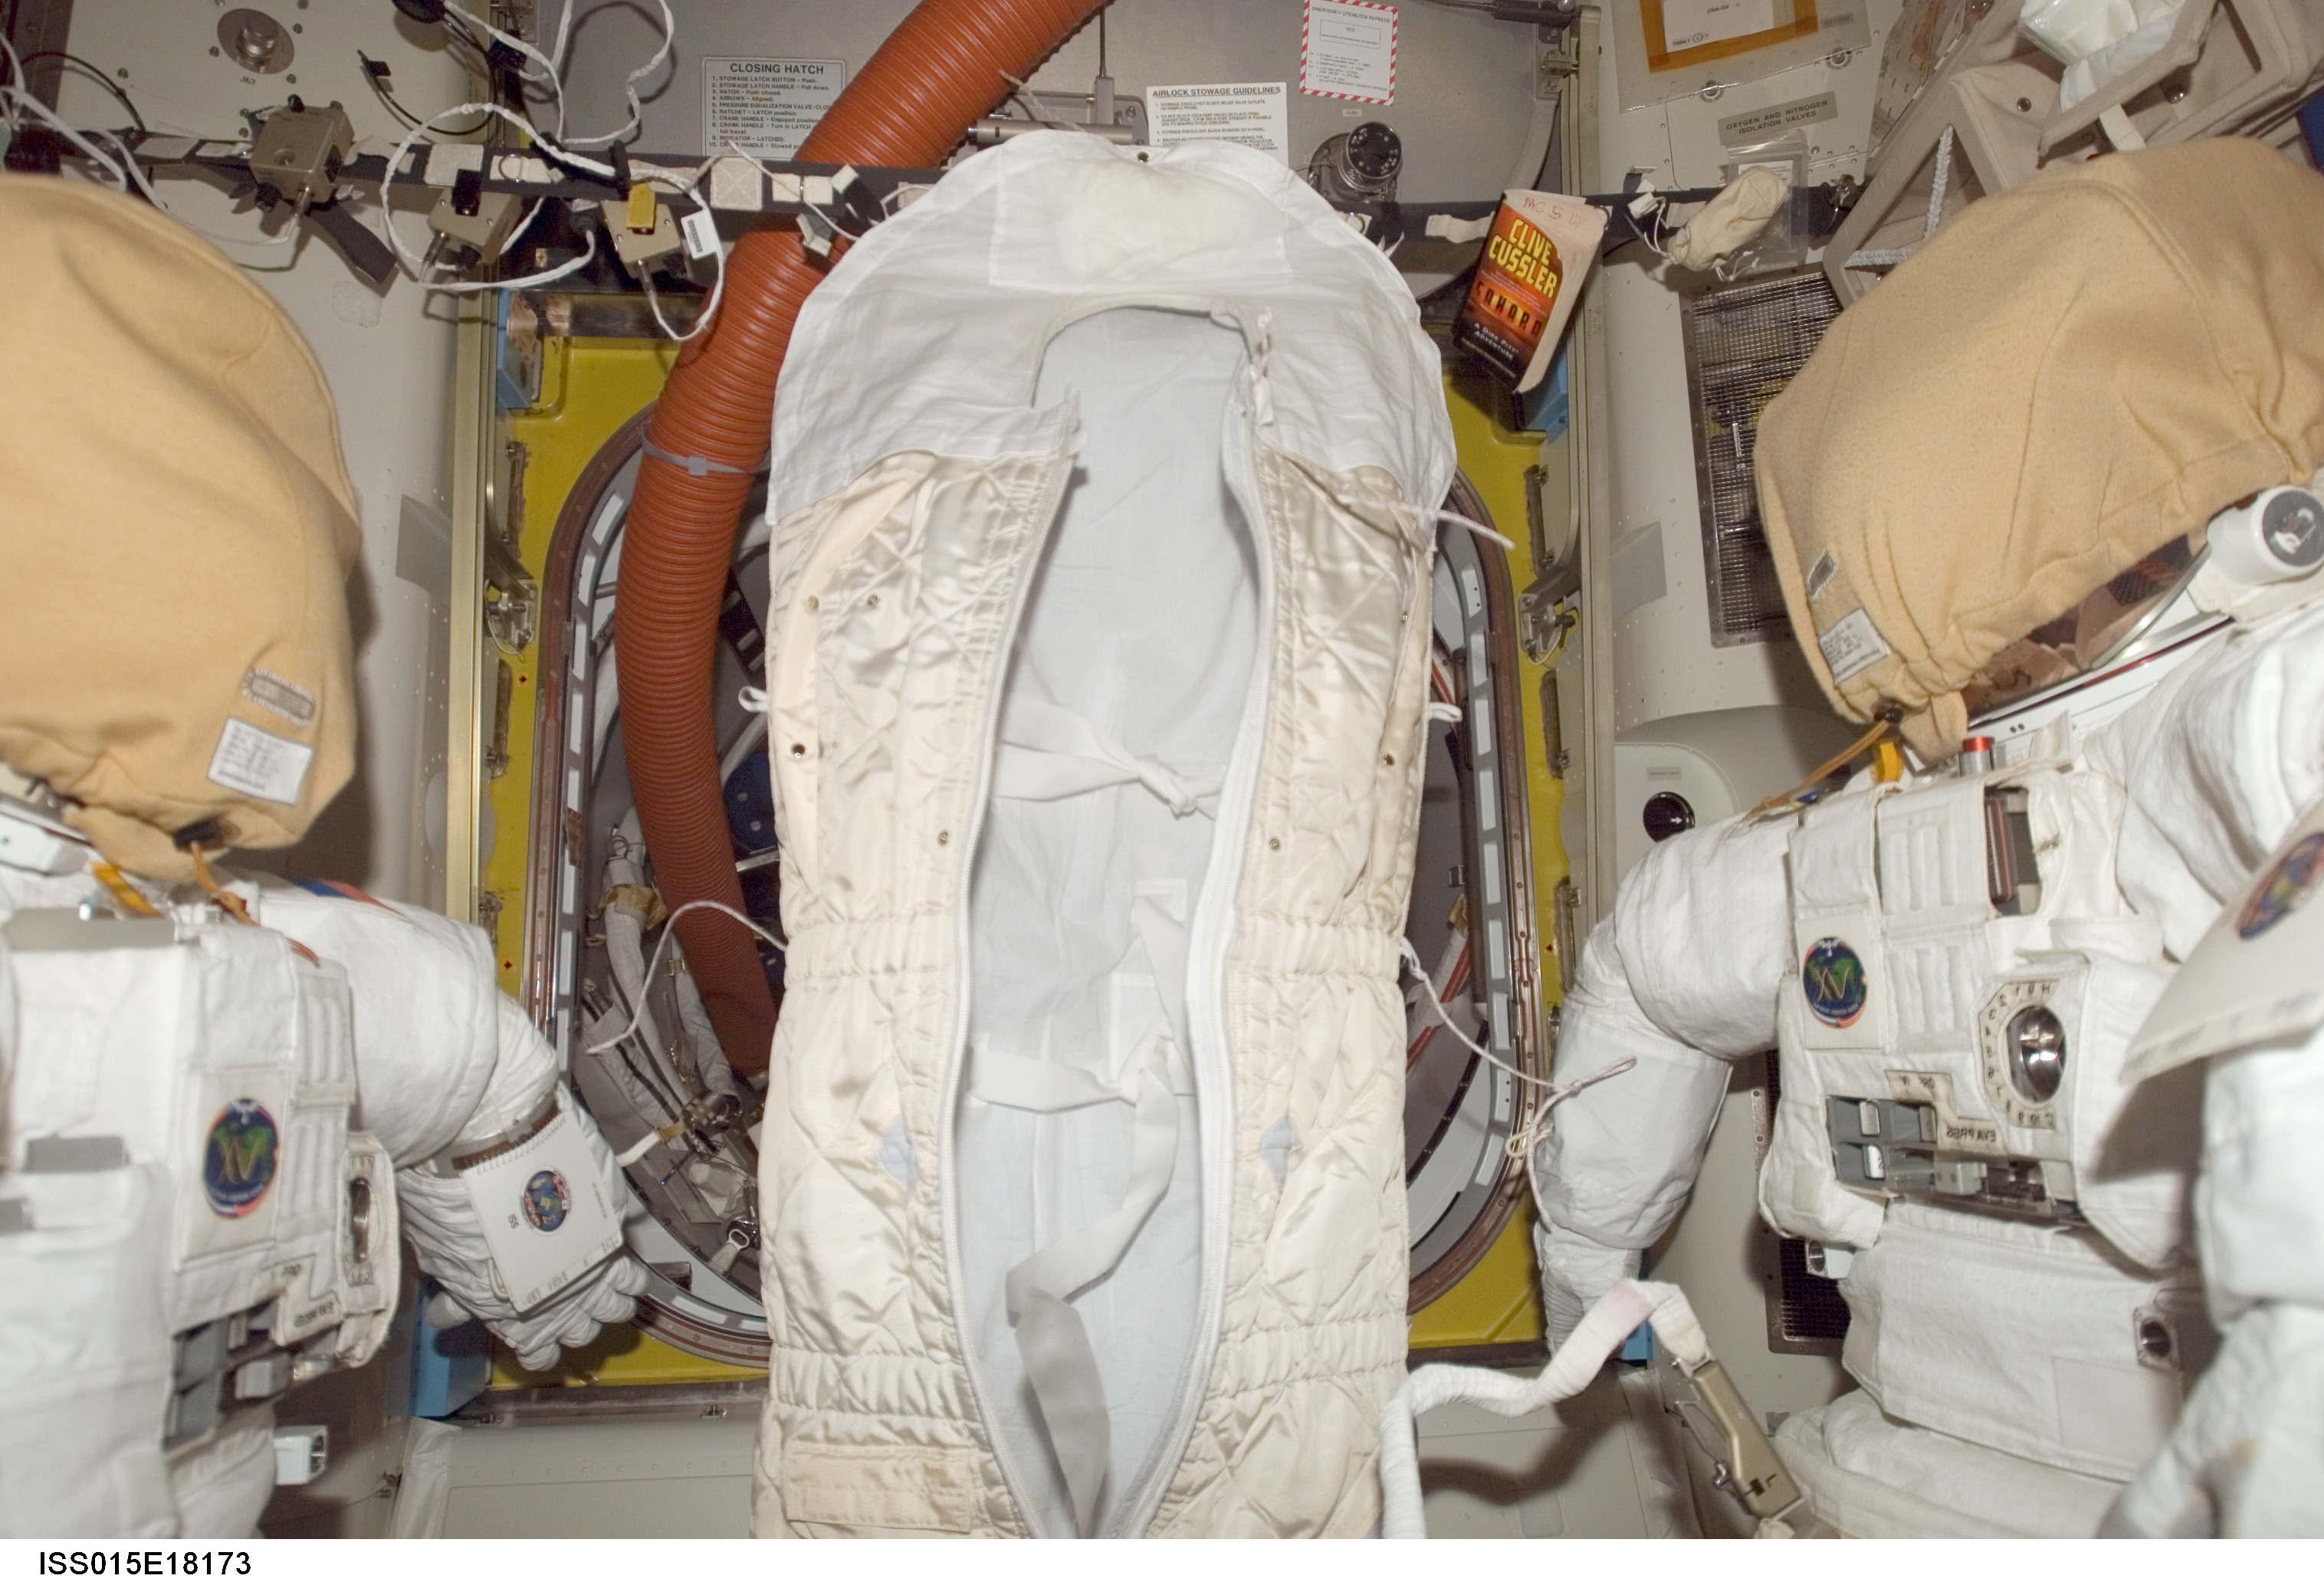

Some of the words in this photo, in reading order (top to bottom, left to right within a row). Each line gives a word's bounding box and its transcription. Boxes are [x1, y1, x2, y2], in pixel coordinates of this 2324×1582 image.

[730, 63, 780, 73] CLOSING
[785, 64, 824, 74] HATCH
[1153, 89, 1189, 97] AIRLOCK
[1233, 86, 1281, 94] GUIDELINES
[1726, 117, 1760, 130] OXYGEN
[1764, 112, 1781, 121] AND
[1785, 100, 1828, 116] NITROGEN
[1738, 120, 1781, 135] ISOLATION
[1786, 110, 1817, 123] VALVES
[1509, 218, 1553, 265] CLIVE
[1489, 235, 1558, 298] CUSSLER
[1475, 281, 1543, 339] SAHARA
[1475, 330, 1514, 359] ADVENTURE
[507, 1213, 519, 1229] ISS
